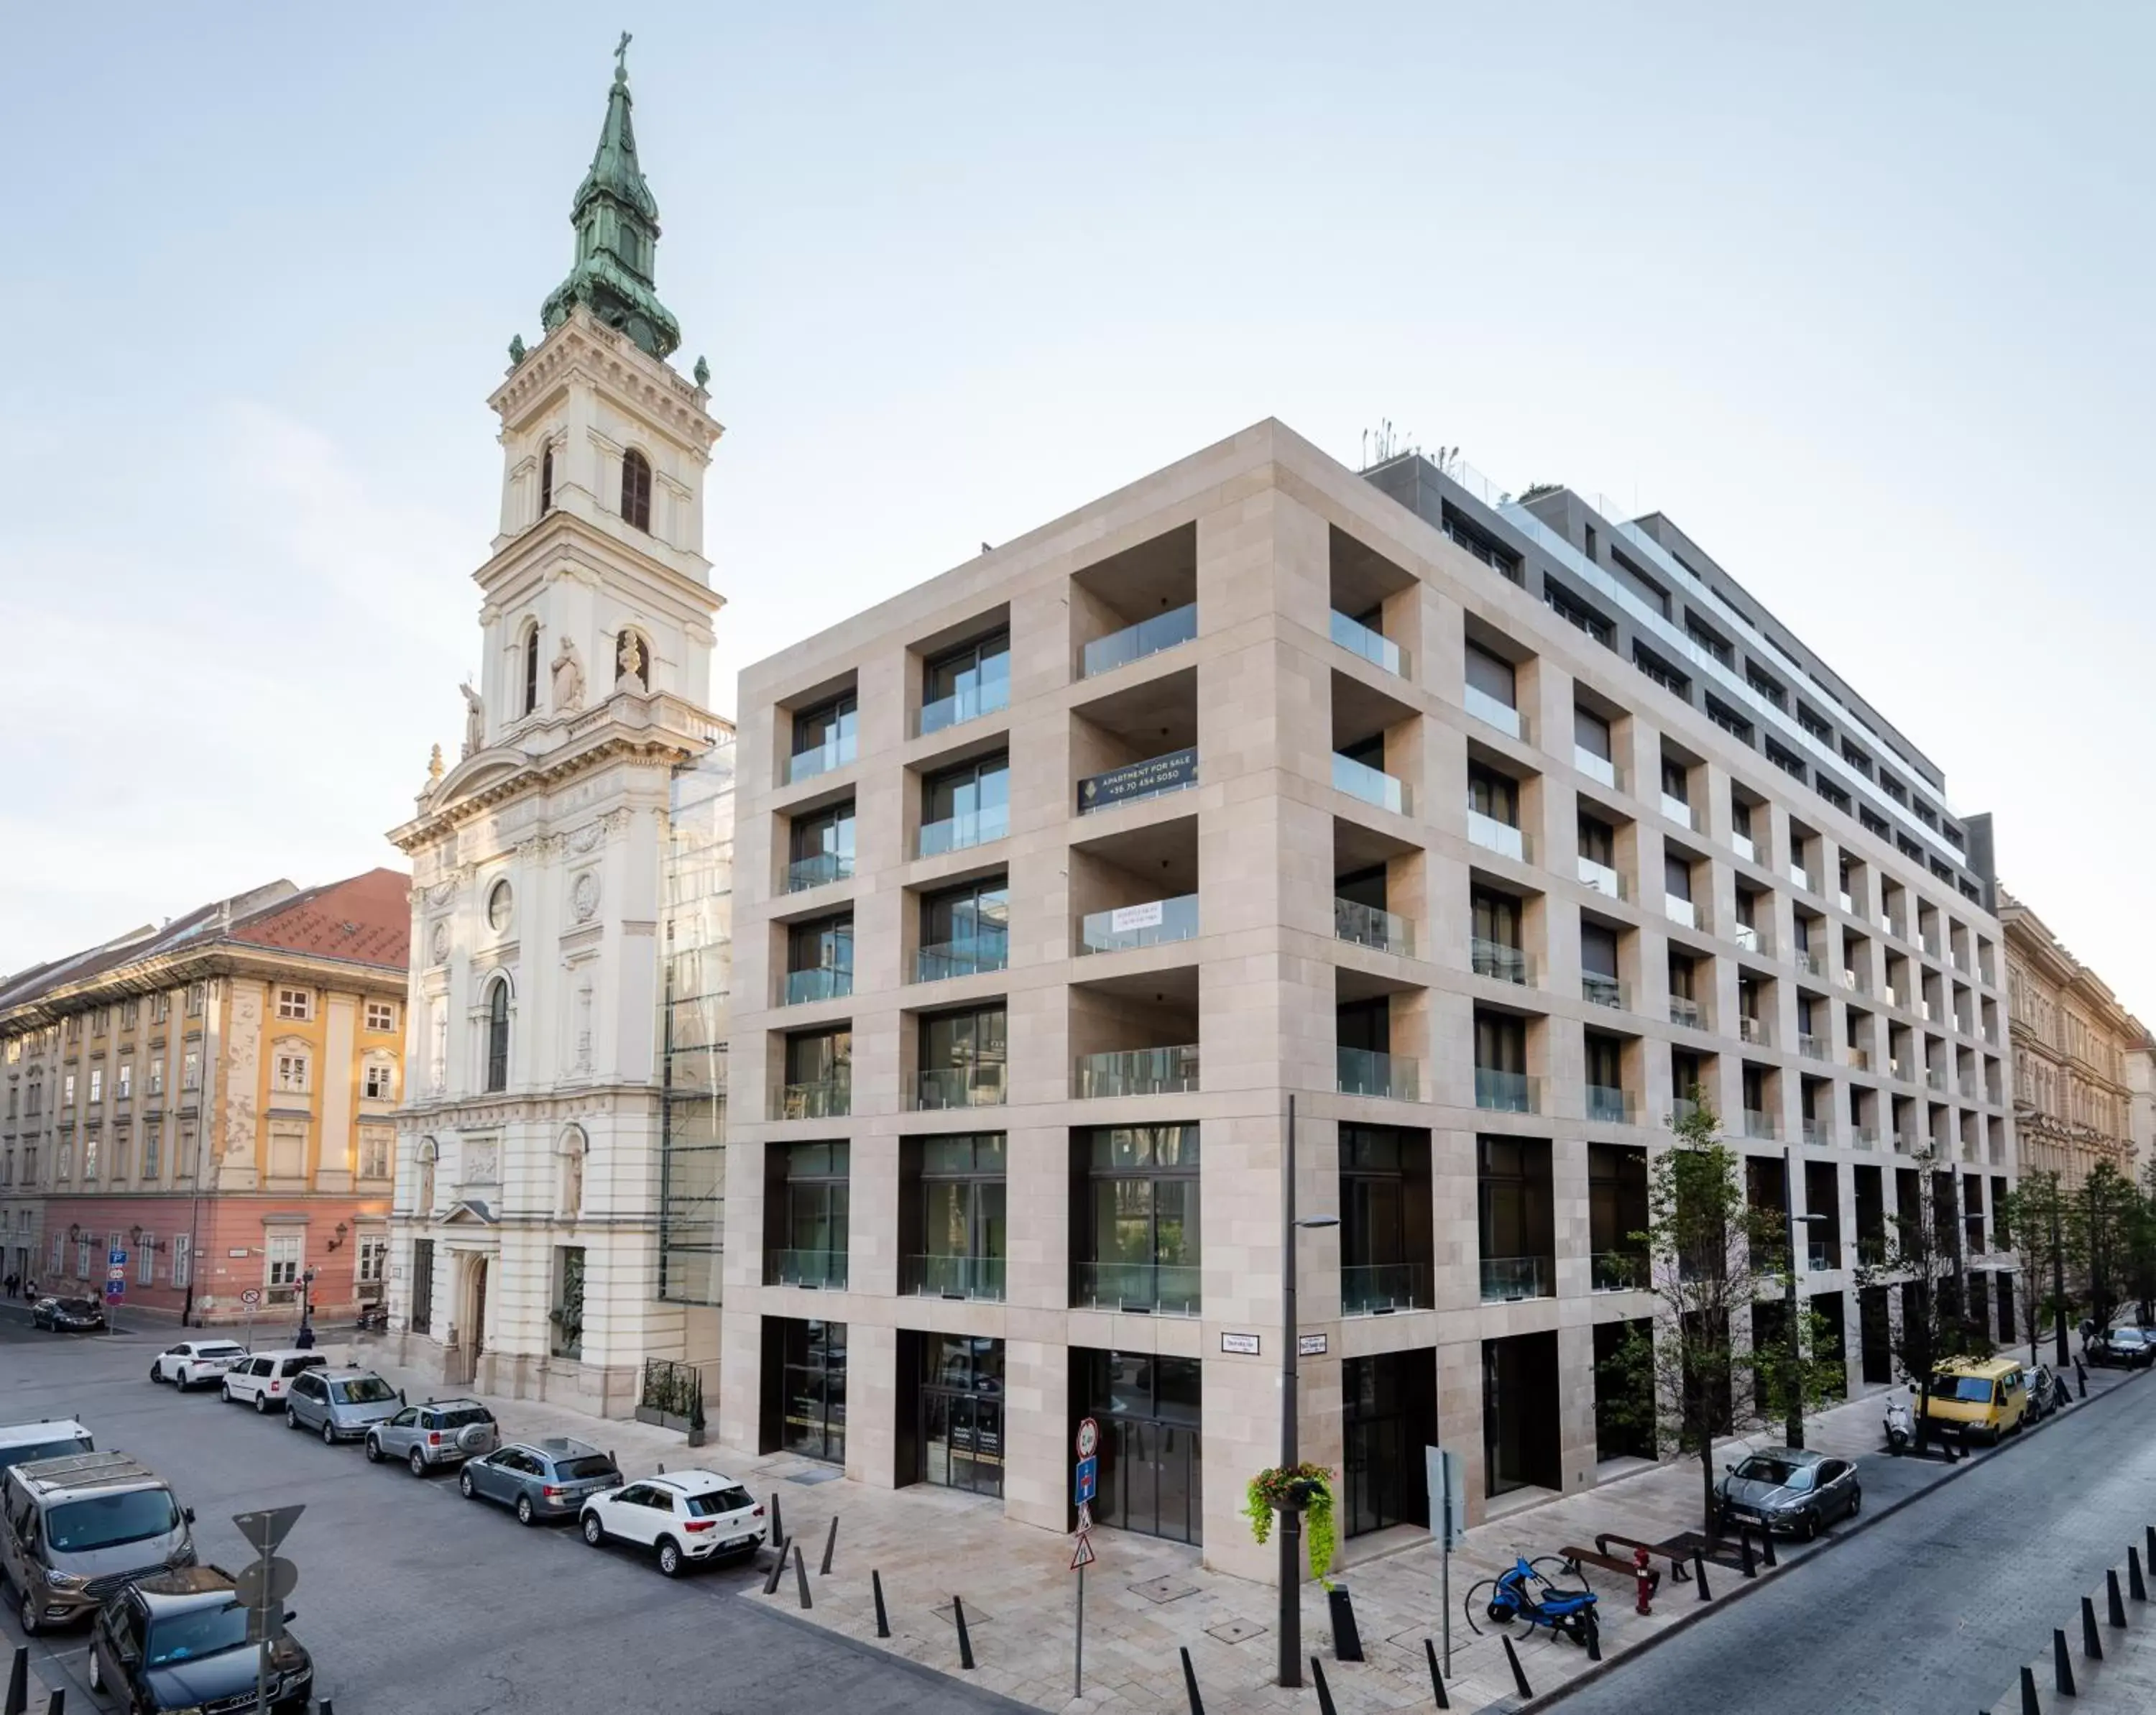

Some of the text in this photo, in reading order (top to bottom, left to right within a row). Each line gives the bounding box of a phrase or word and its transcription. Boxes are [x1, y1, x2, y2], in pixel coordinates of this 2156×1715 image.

[1102, 755, 1191, 786] APARTMENT FOR SALE
